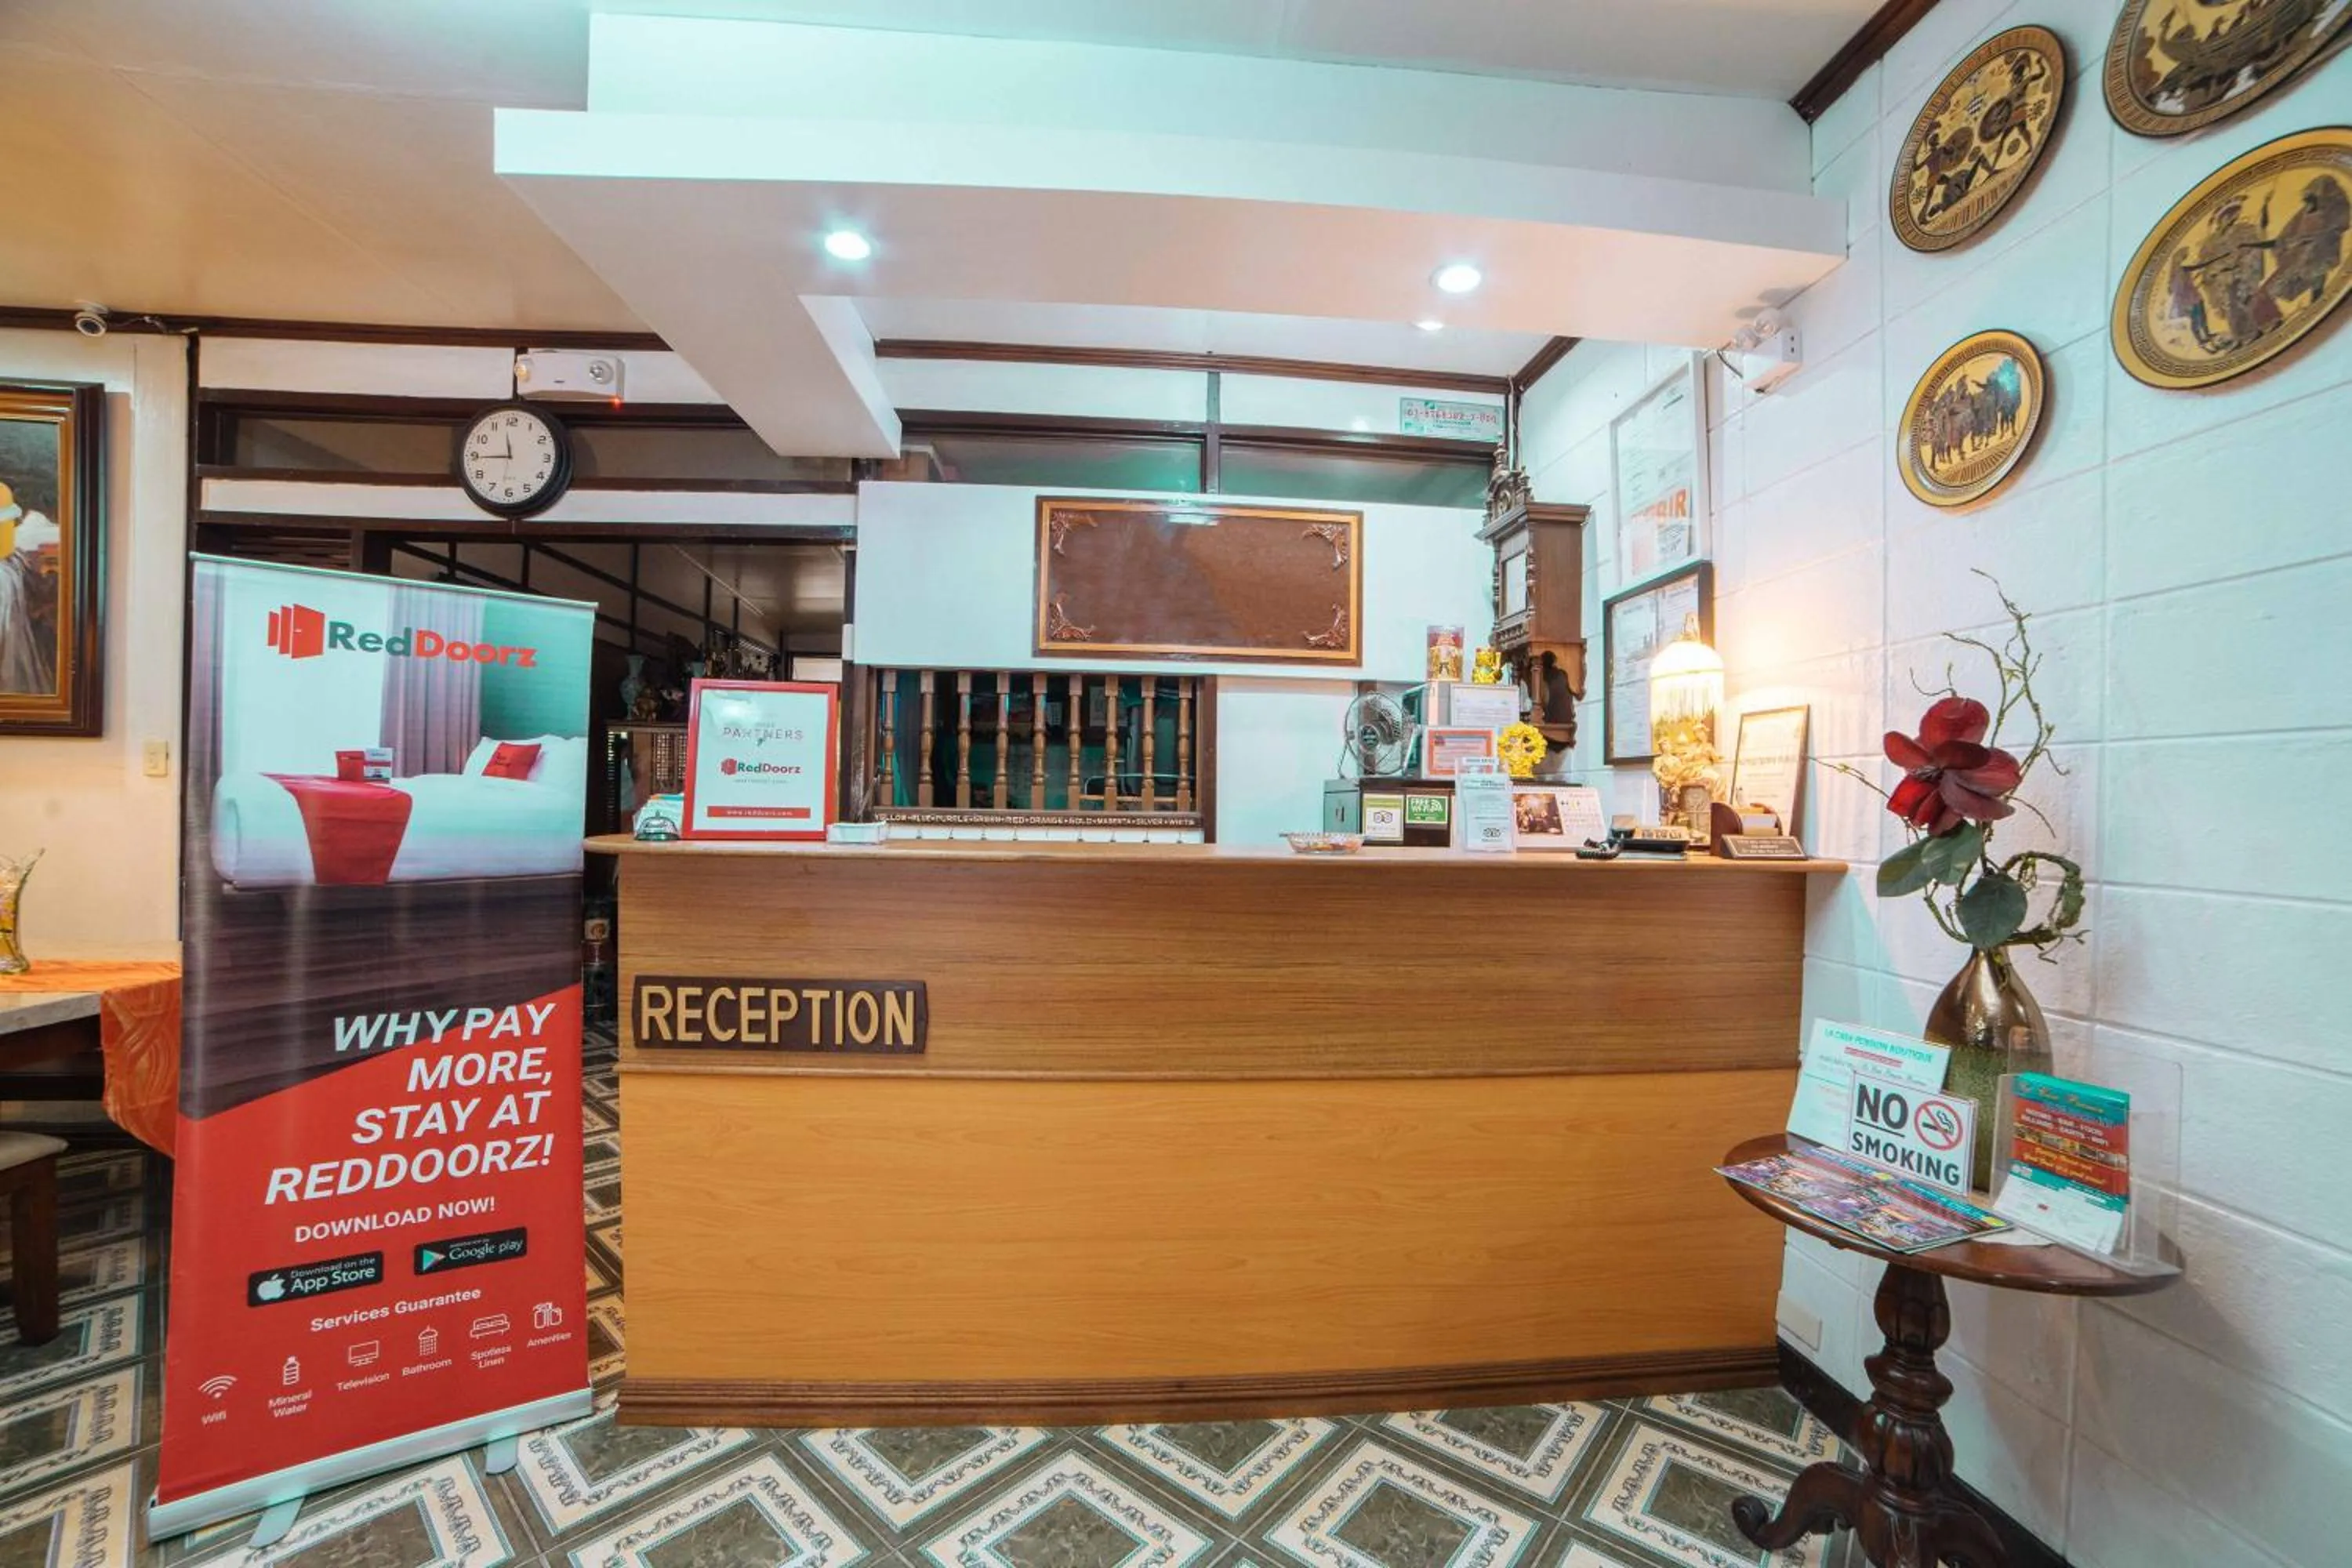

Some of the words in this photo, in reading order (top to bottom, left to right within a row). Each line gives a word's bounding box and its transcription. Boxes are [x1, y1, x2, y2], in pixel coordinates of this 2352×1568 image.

[491, 422, 498, 431] 11
[506, 417, 518, 426] 12
[477, 434, 488, 445] 10
[537, 435, 546, 445] 2
[470, 452, 479, 461] 9
[543, 453, 551, 463] 3
[476, 470, 484, 479] 8
[536, 471, 545, 480] 4
[488, 482, 496, 492] 7
[504, 488, 514, 497] 6
[523, 484, 531, 493] 5
[328, 621, 537, 668] RedDoorz
[738, 762, 801, 775] RedDoorz
[641, 985, 915, 1046] RECEPTION
[333, 1009, 457, 1052] WHY
[461, 1003, 557, 1041] PAY
[407, 1047, 553, 1092] MORE,
[1855, 1083, 1909, 1130] NO
[351, 1098, 481, 1145] STAY
[488, 1091, 552, 1129] AT
[1851, 1132, 1960, 1188] SMOKING
[264, 1133, 554, 1206] REDDOORZ!
[294, 1207, 431, 1243] DOWNLOAD
[437, 1196, 496, 1219] NOW!
[449, 1243, 495, 1259] Google
[499, 1240, 523, 1254] play
[290, 1262, 343, 1279] Download
[291, 1277, 328, 1293] App
[331, 1268, 376, 1285] Store
[310, 1307, 390, 1332] Services
[395, 1287, 481, 1313] Guarantee
[471, 1345, 511, 1360] Spotless
[401, 1359, 452, 1377] Bathroom
[478, 1357, 505, 1369] Linen
[337, 1373, 390, 1392] Television
[268, 1390, 313, 1408] Mineral
[274, 1403, 308, 1417] Water
